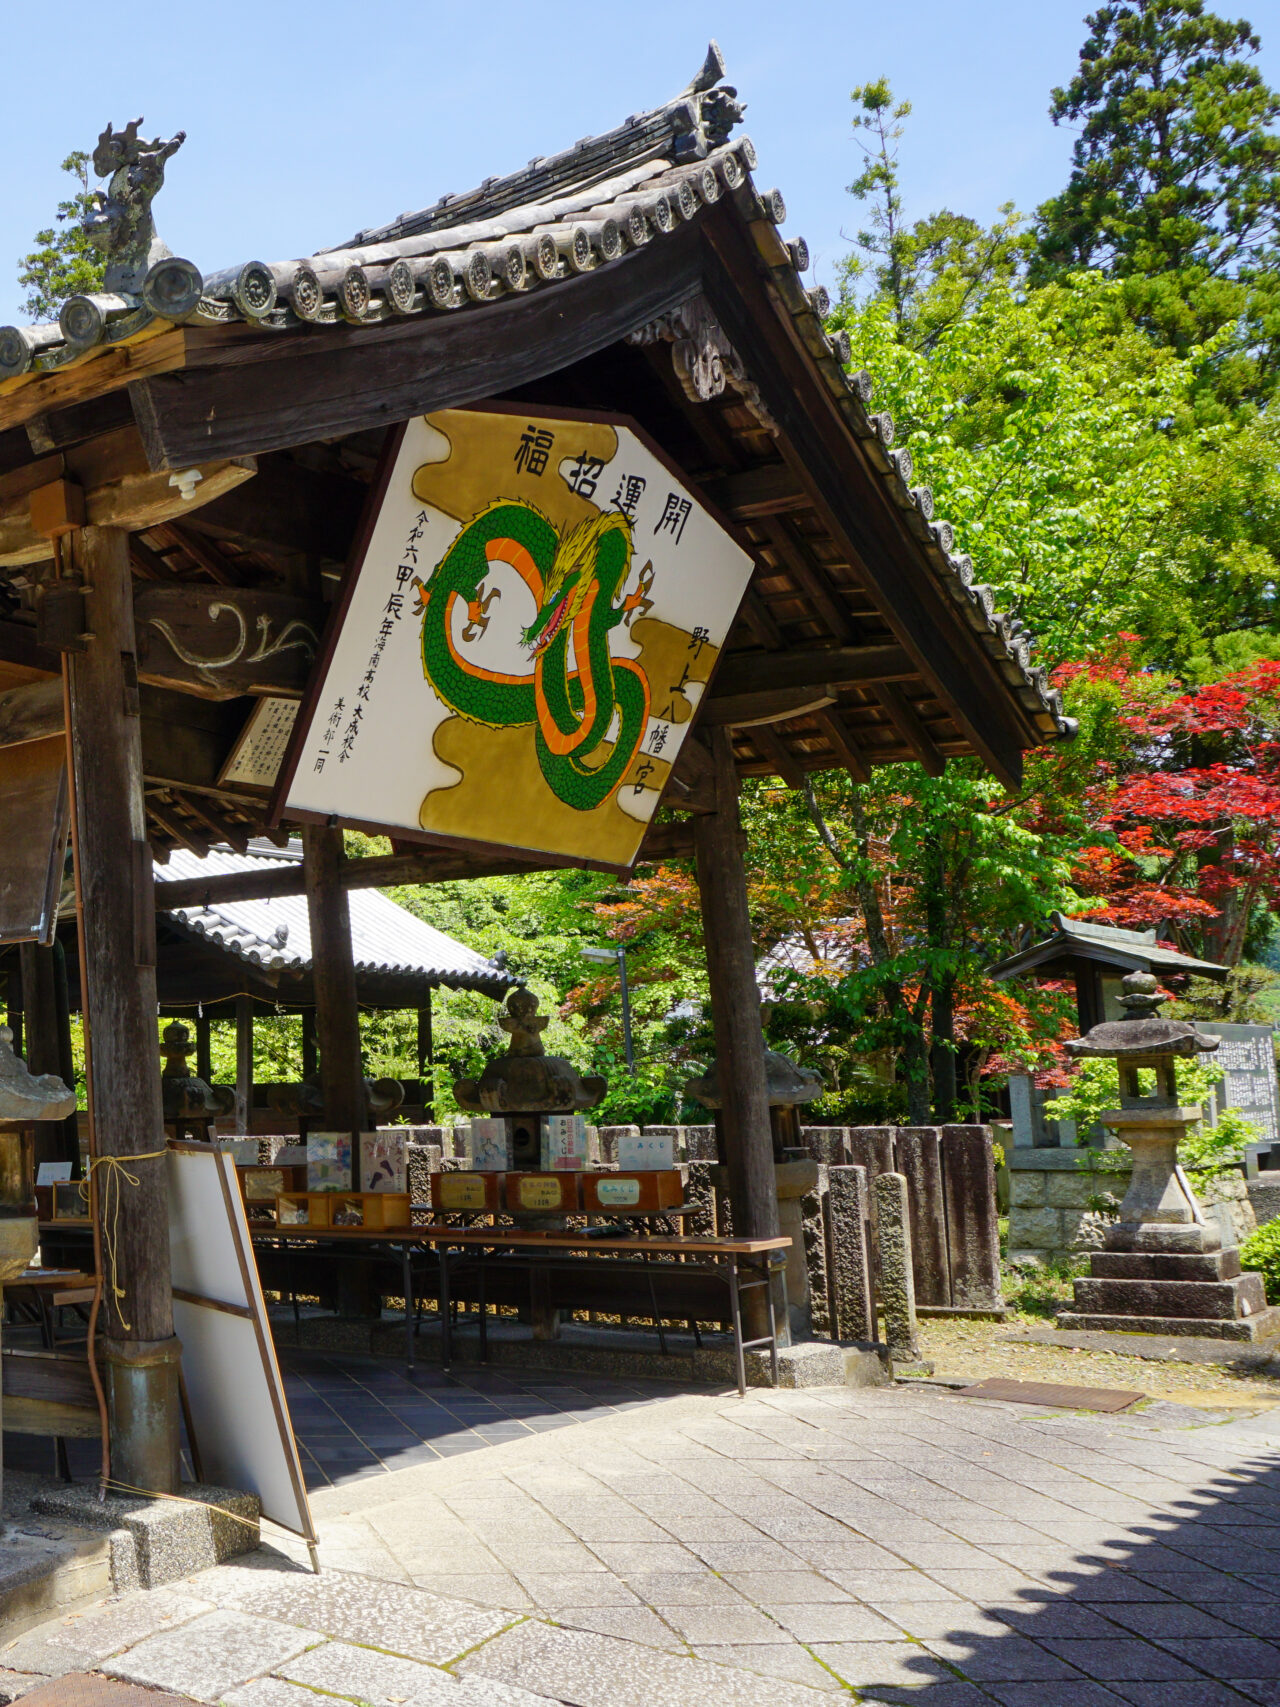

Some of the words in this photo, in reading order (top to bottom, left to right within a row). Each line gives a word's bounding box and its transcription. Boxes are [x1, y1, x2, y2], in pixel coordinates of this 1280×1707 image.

[633, 625, 711, 797] 野上八幡宮
